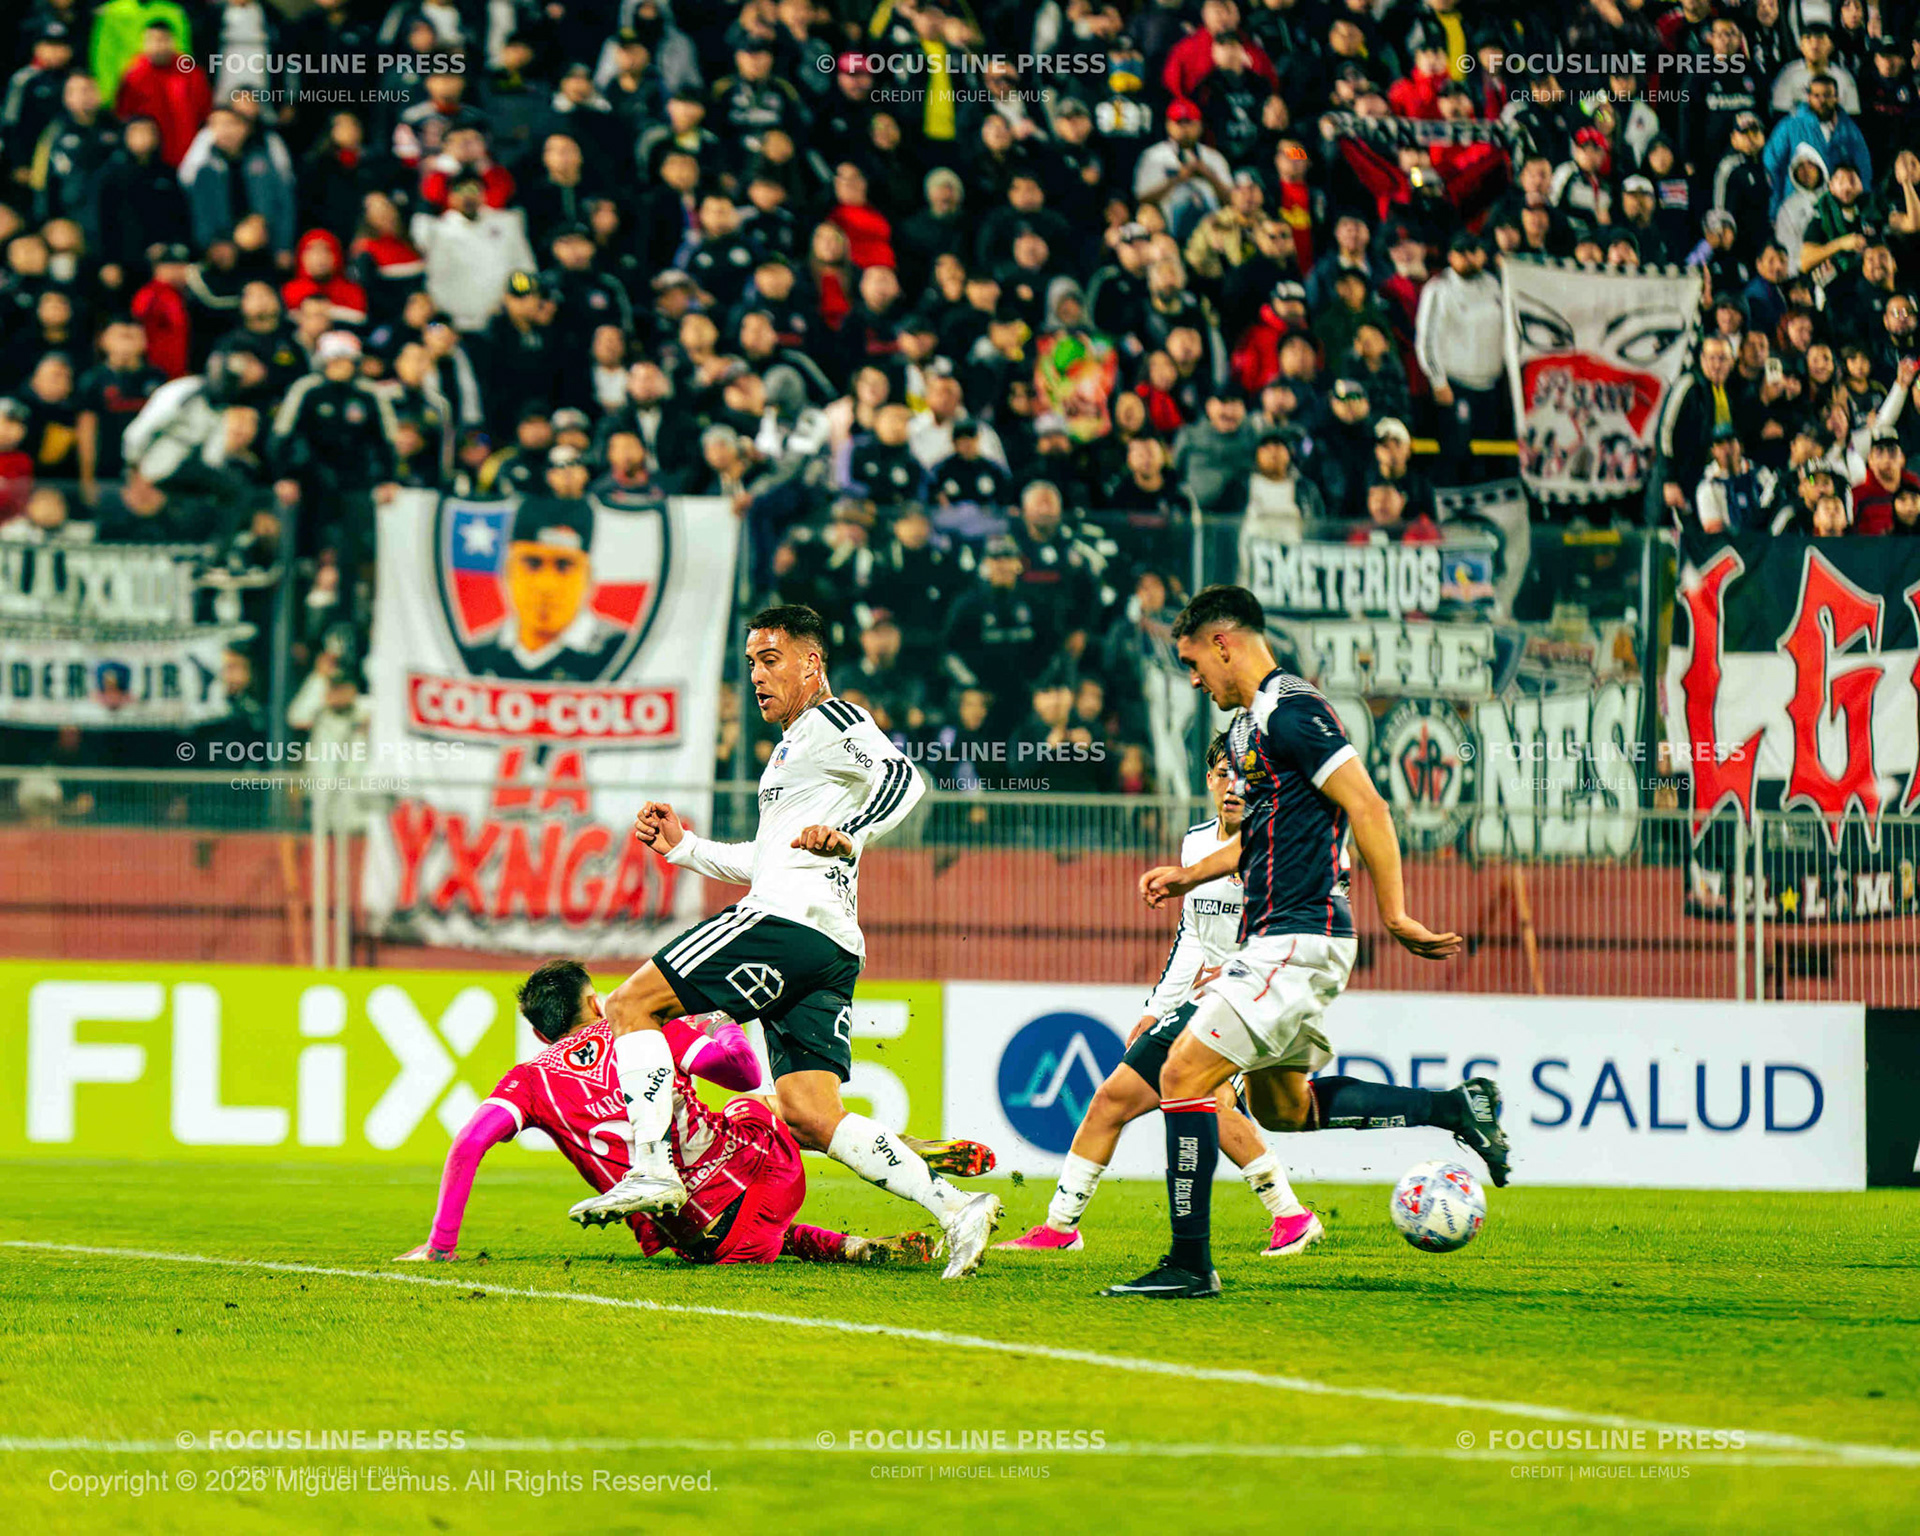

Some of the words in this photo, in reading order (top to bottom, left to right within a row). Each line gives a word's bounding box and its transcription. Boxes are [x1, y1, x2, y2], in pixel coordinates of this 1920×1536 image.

[1252, 543, 1441, 619] EMETERIOS
[1314, 622, 1493, 696] THE
[416, 683, 669, 736] COLO-COLO
[1676, 545, 1920, 855] LG
[492, 745, 590, 814] LA
[1530, 1058, 1824, 1133] SALUD
